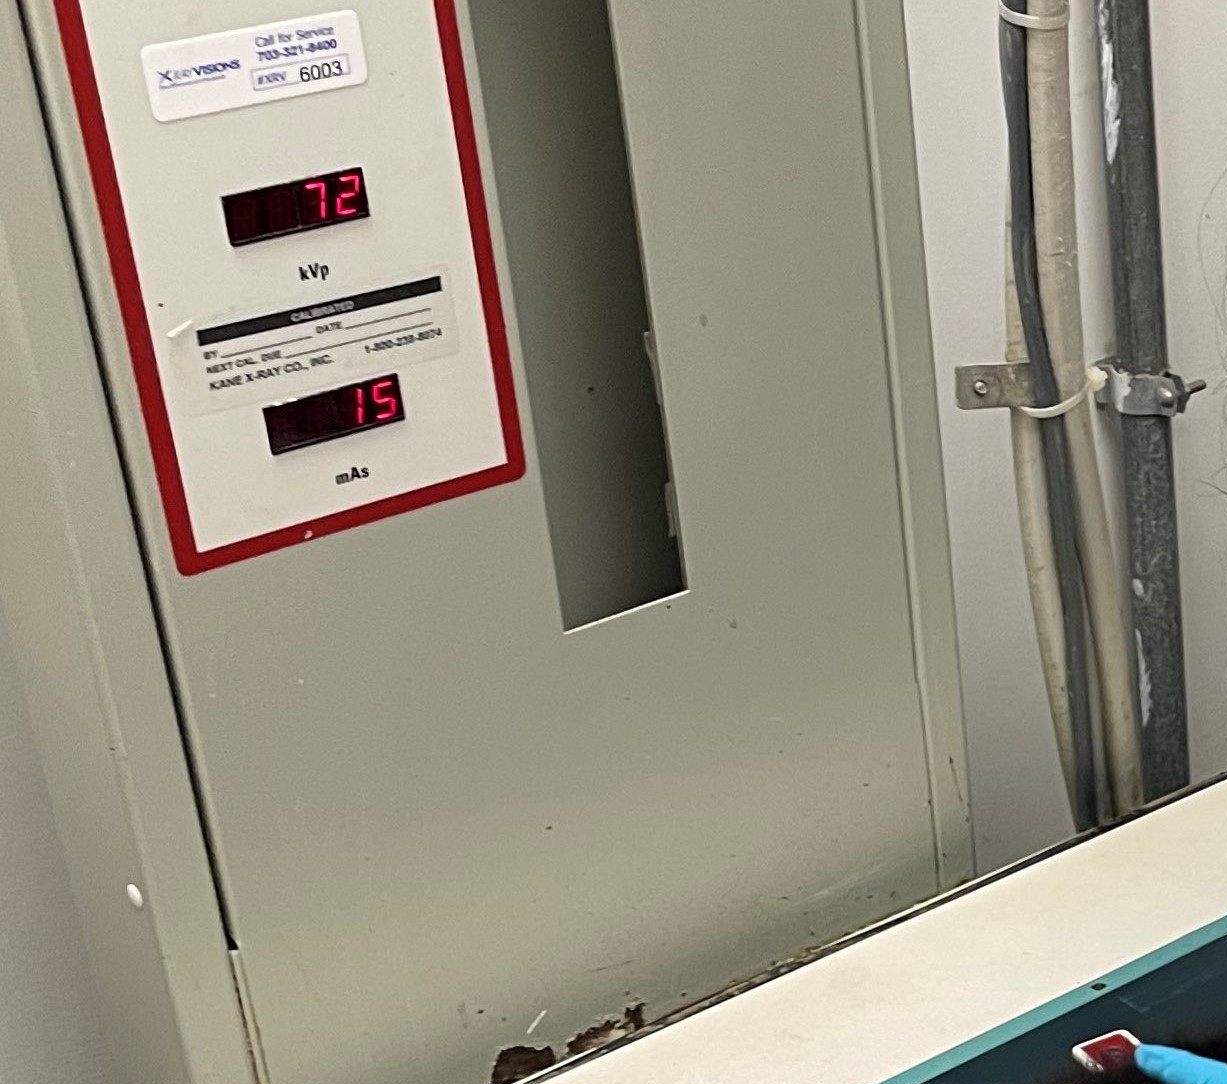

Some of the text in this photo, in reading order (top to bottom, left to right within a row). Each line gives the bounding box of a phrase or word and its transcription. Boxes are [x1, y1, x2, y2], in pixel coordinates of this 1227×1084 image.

[255, 26, 335, 48] Call for Service
[299, 60, 343, 82] 6003
[305, 175, 360, 218] 72
[299, 263, 330, 281] kVp
[290, 300, 355, 322] CALIBRATED
[203, 321, 342, 361] BY DATE
[206, 361, 234, 374] NEXT
[209, 375, 244, 391] KANE
[244, 365, 281, 383] X-RAY
[355, 381, 397, 424] 15
[335, 467, 370, 485] mAs
